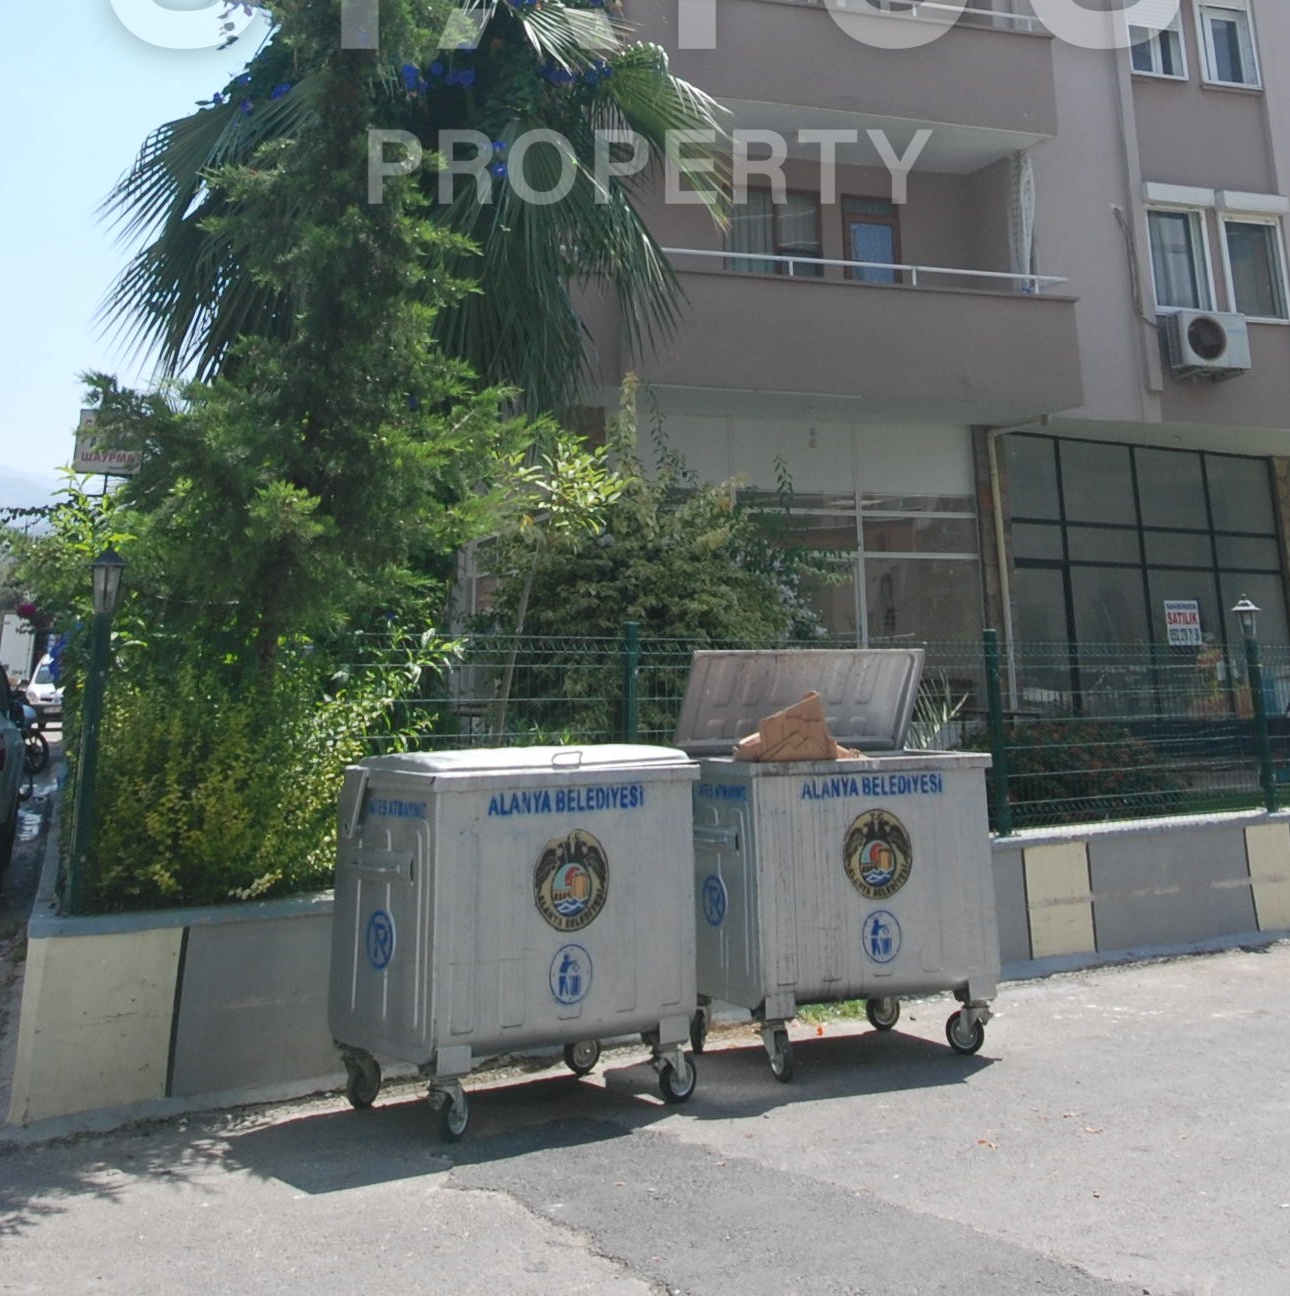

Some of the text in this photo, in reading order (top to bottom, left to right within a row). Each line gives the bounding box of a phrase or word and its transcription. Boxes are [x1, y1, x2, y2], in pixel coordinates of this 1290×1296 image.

[1167, 612, 1199, 625] SATILIK
[802, 776, 858, 800] ALANYA
[488, 789, 551, 816] ALANYA
